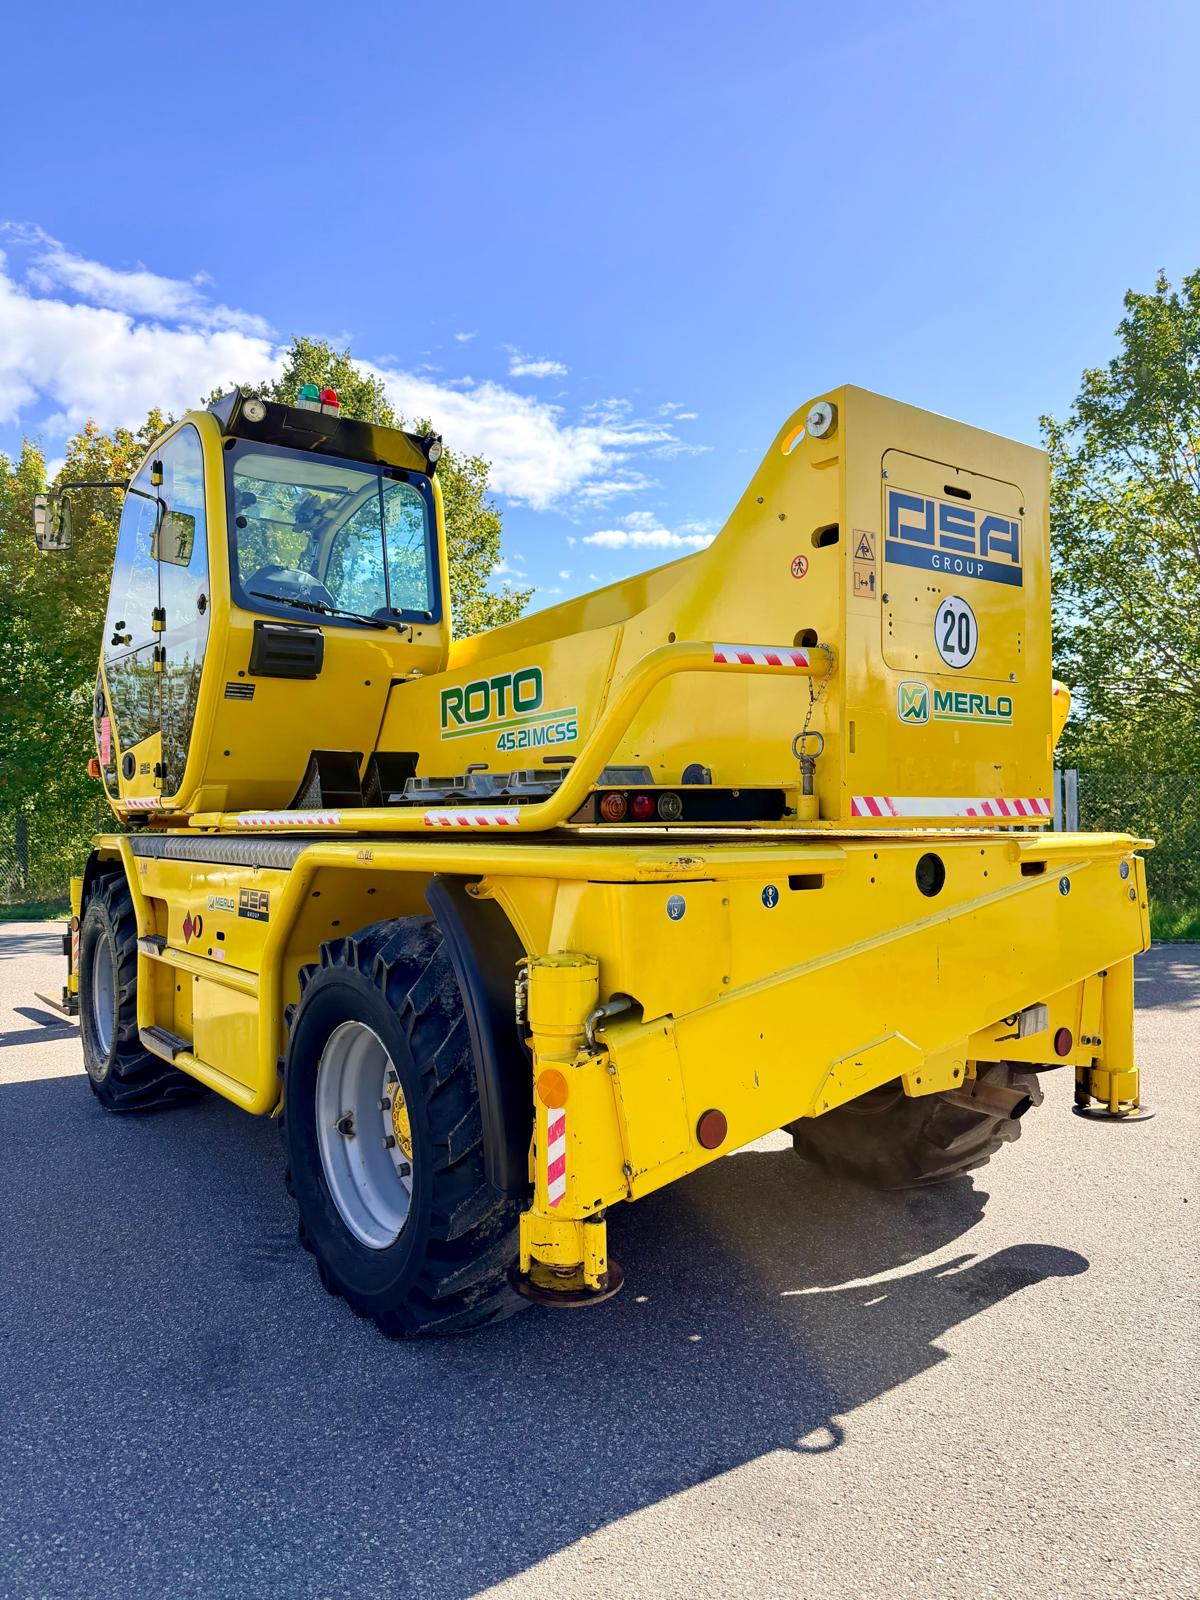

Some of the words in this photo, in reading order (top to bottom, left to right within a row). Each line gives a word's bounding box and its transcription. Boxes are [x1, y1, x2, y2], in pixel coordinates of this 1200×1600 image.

[931, 554, 984, 576] GROUP
[943, 609, 970, 656] 20
[440, 667, 543, 728] ROTO
[934, 690, 1012, 717] MERLO
[215, 896, 234, 908] MERLO
